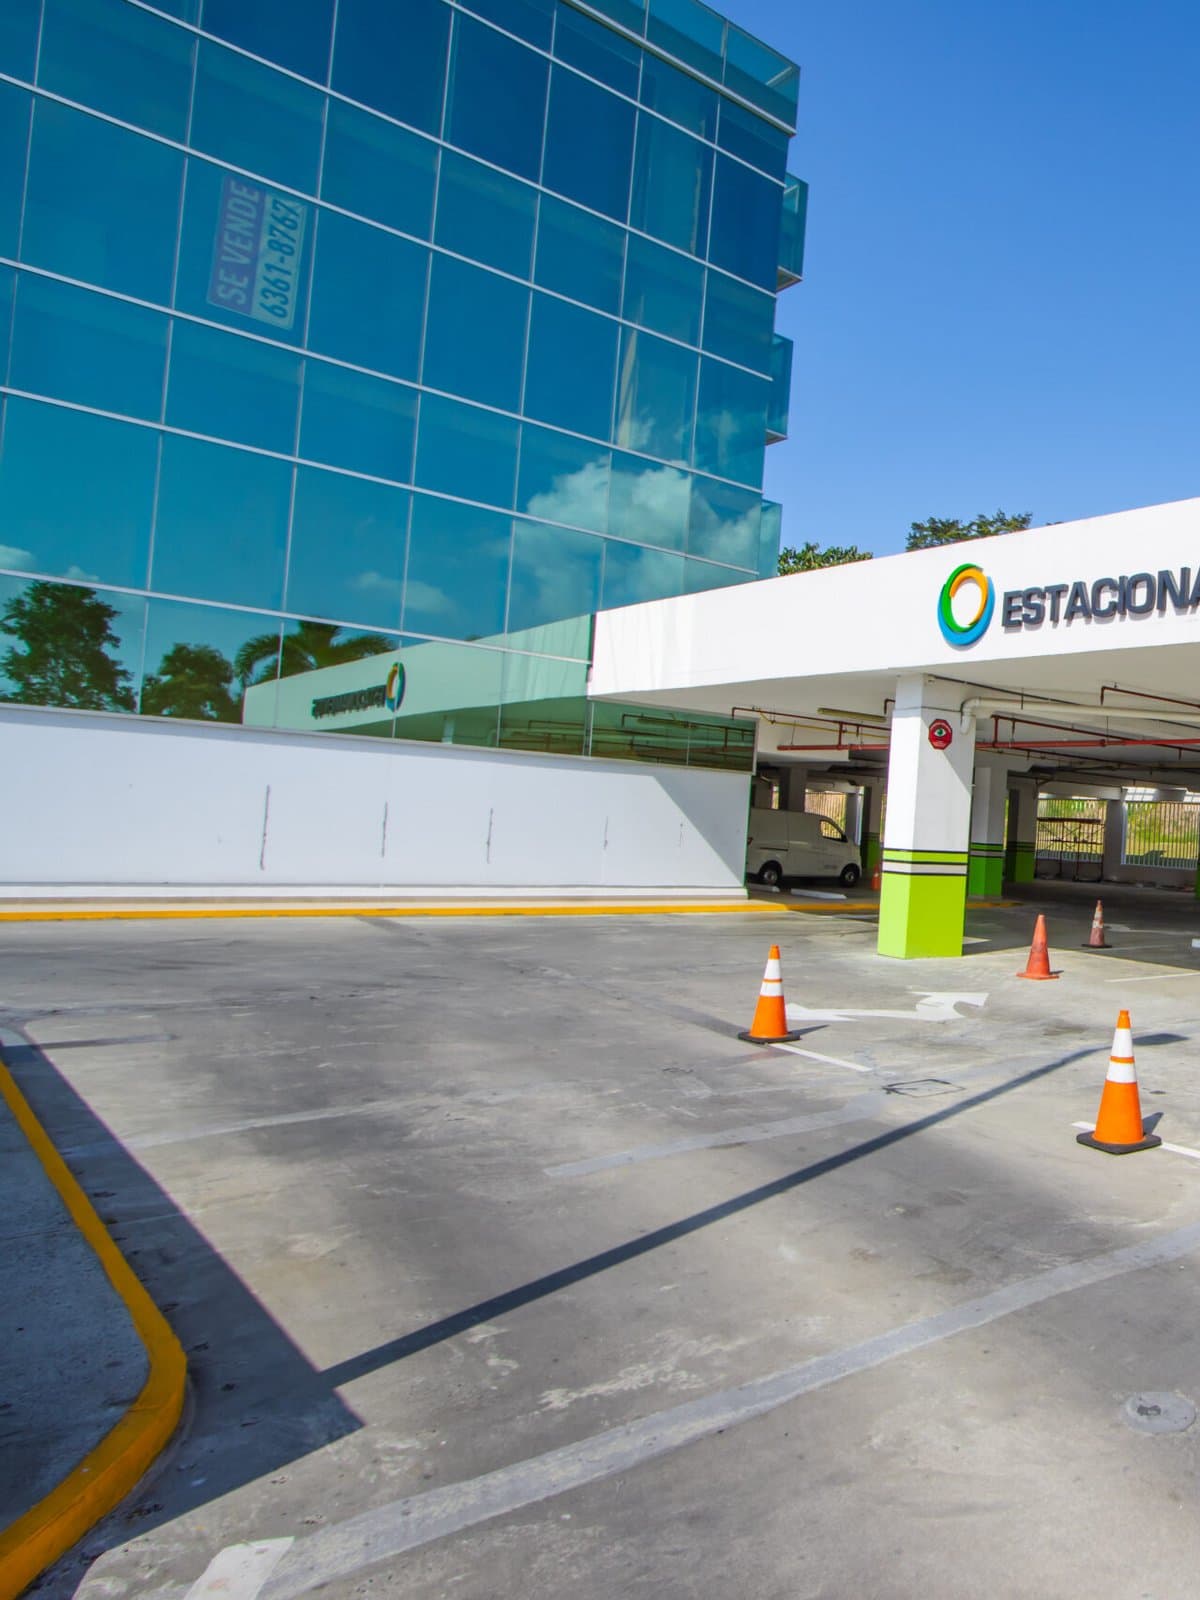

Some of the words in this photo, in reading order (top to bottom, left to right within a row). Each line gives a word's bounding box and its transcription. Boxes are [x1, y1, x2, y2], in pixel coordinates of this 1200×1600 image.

[220, 180, 260, 265] VENDE
[259, 199, 301, 318] 6361-8767
[218, 268, 249, 305] SE
